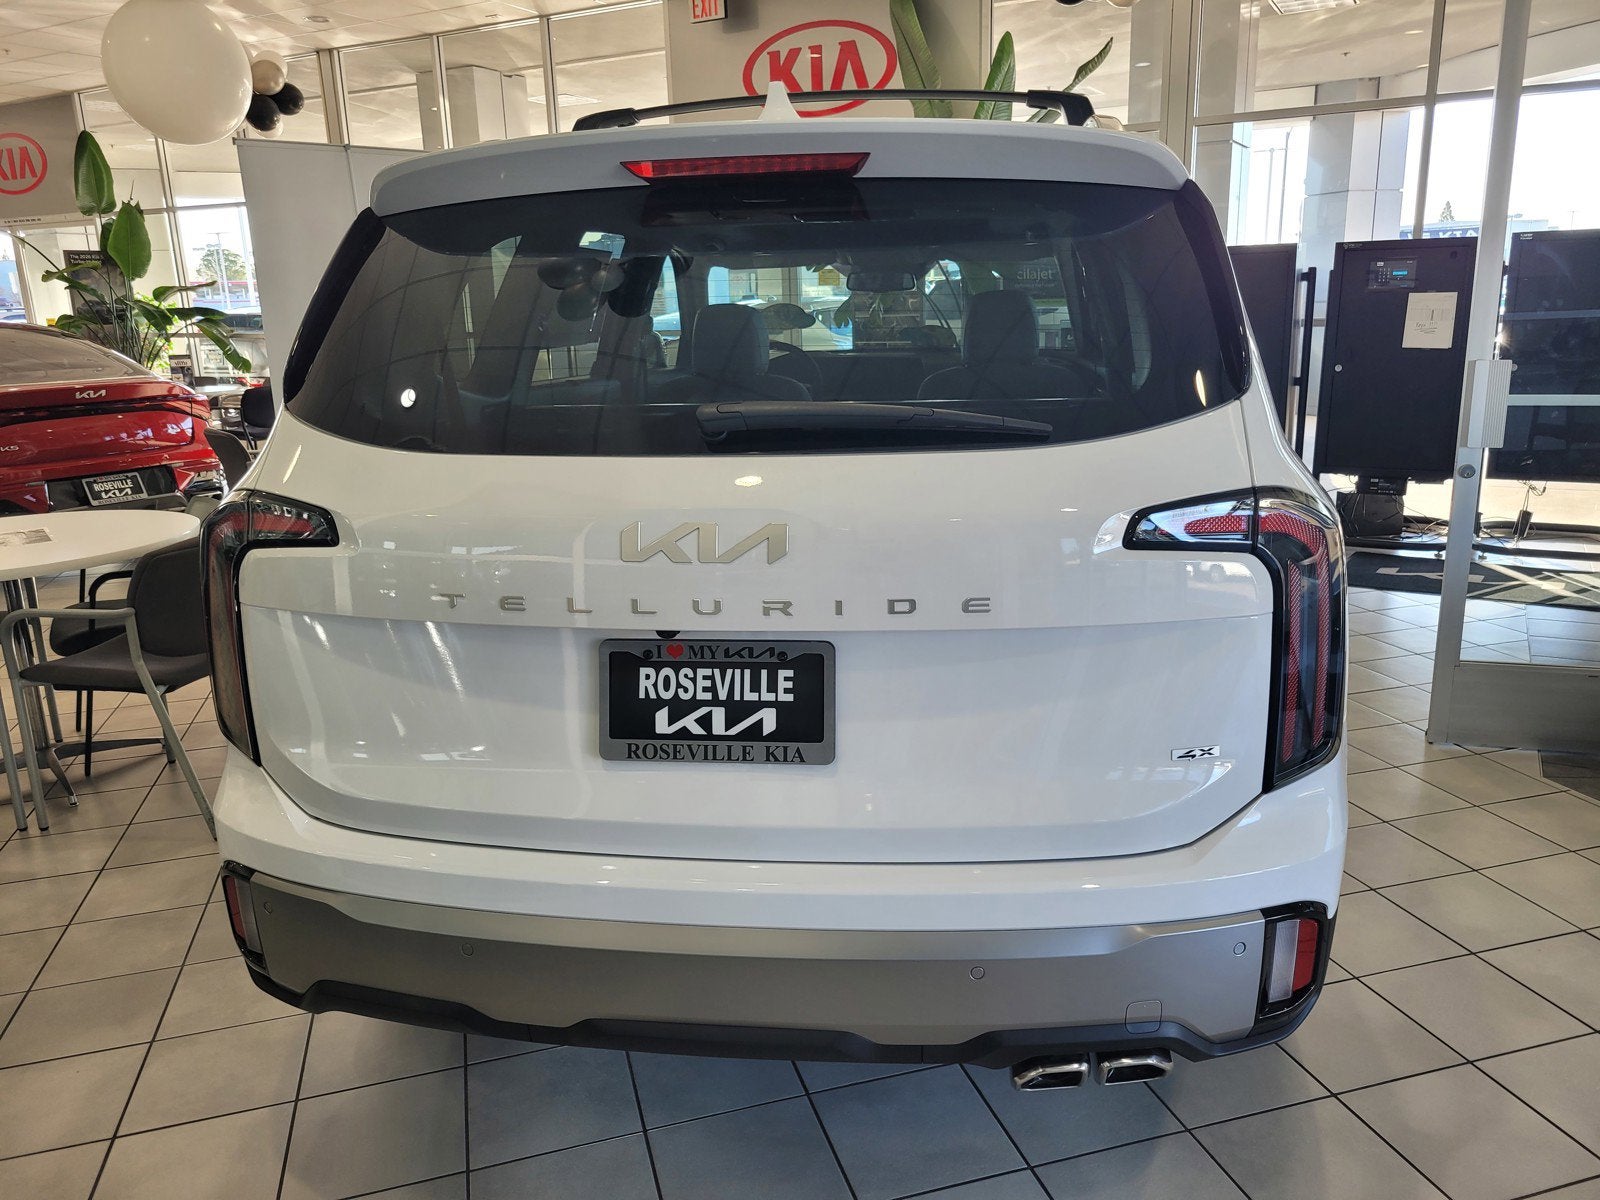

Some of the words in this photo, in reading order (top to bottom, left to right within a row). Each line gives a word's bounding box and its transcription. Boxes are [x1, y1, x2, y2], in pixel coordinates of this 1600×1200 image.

[767, 40, 870, 93] KIA
[75, 389, 107, 399] KIA
[93, 479, 134, 492] ROSEVILLE
[101, 487, 132, 499] KIA
[620, 521, 790, 565] KIA
[439, 592, 992, 617] TELLURIDE
[656, 644, 663, 659] I
[687, 645, 720, 660] MY
[723, 646, 776, 659] KIA
[638, 667, 794, 702] ROSEVILLE
[655, 705, 777, 737] KIA
[626, 742, 755, 762] ROSEVILLE
[763, 745, 806, 763] KIA
